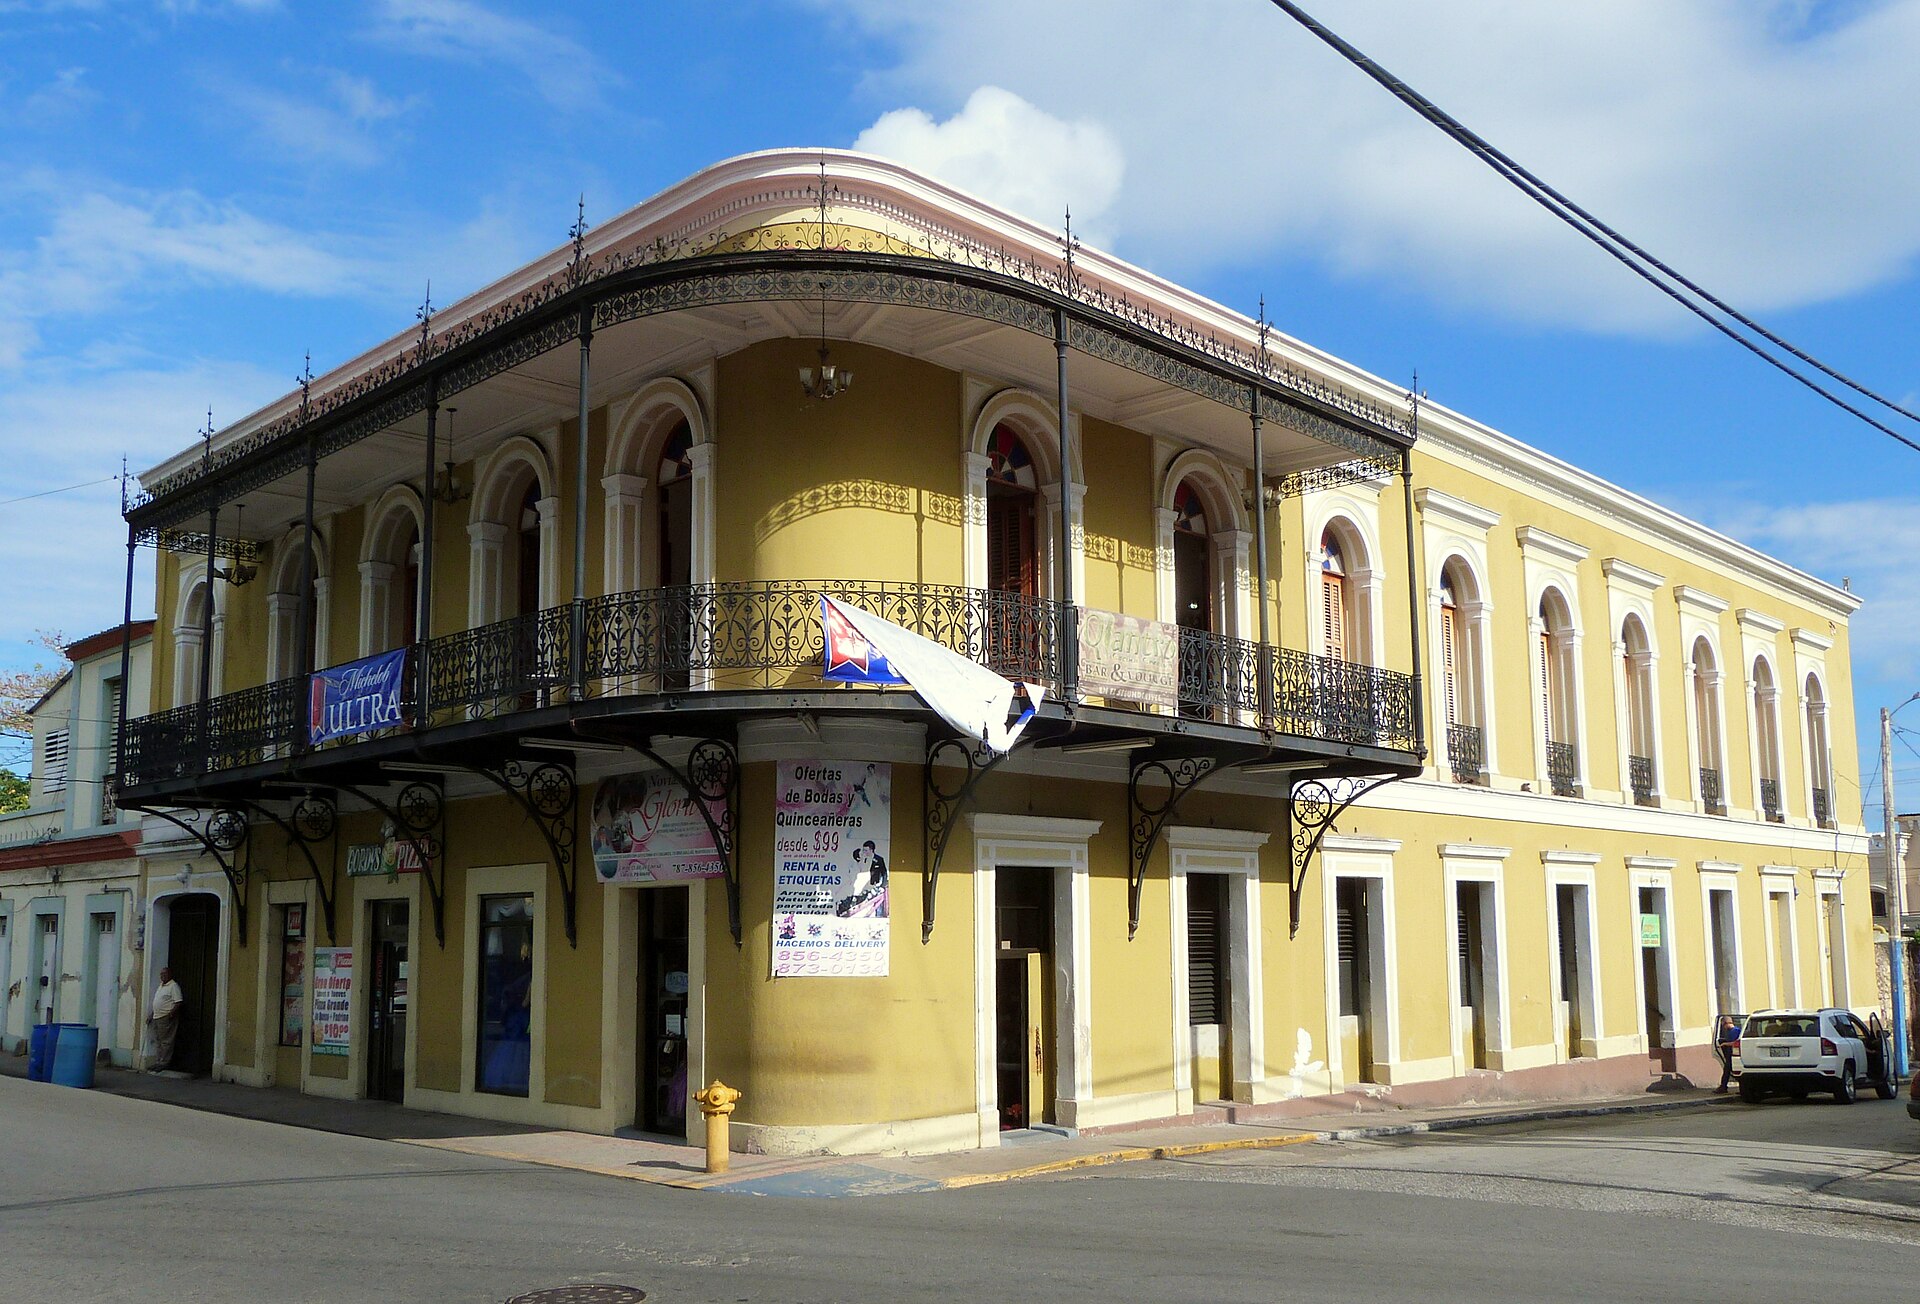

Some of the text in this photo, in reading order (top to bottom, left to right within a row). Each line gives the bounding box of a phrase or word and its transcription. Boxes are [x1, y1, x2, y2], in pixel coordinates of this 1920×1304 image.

[339, 662, 393, 696] Michelob
[1085, 663, 1174, 687] BAR & LOUNGE
[330, 689, 402, 734] ULTRA
[795, 766, 842, 781] Ofertas
[785, 788, 855, 808] de Bodas y
[776, 811, 863, 828] Quinceañeras
[777, 829, 839, 854] desde $99
[783, 861, 837, 872] RENTA de
[778, 875, 842, 886] ETIQUETAS
[775, 940, 886, 948] HACEMOS DELIVERY
[777, 950, 885, 962] 856-4350
[777, 963, 884, 975] 873-0134
[327, 999, 349, 1011] Grande
